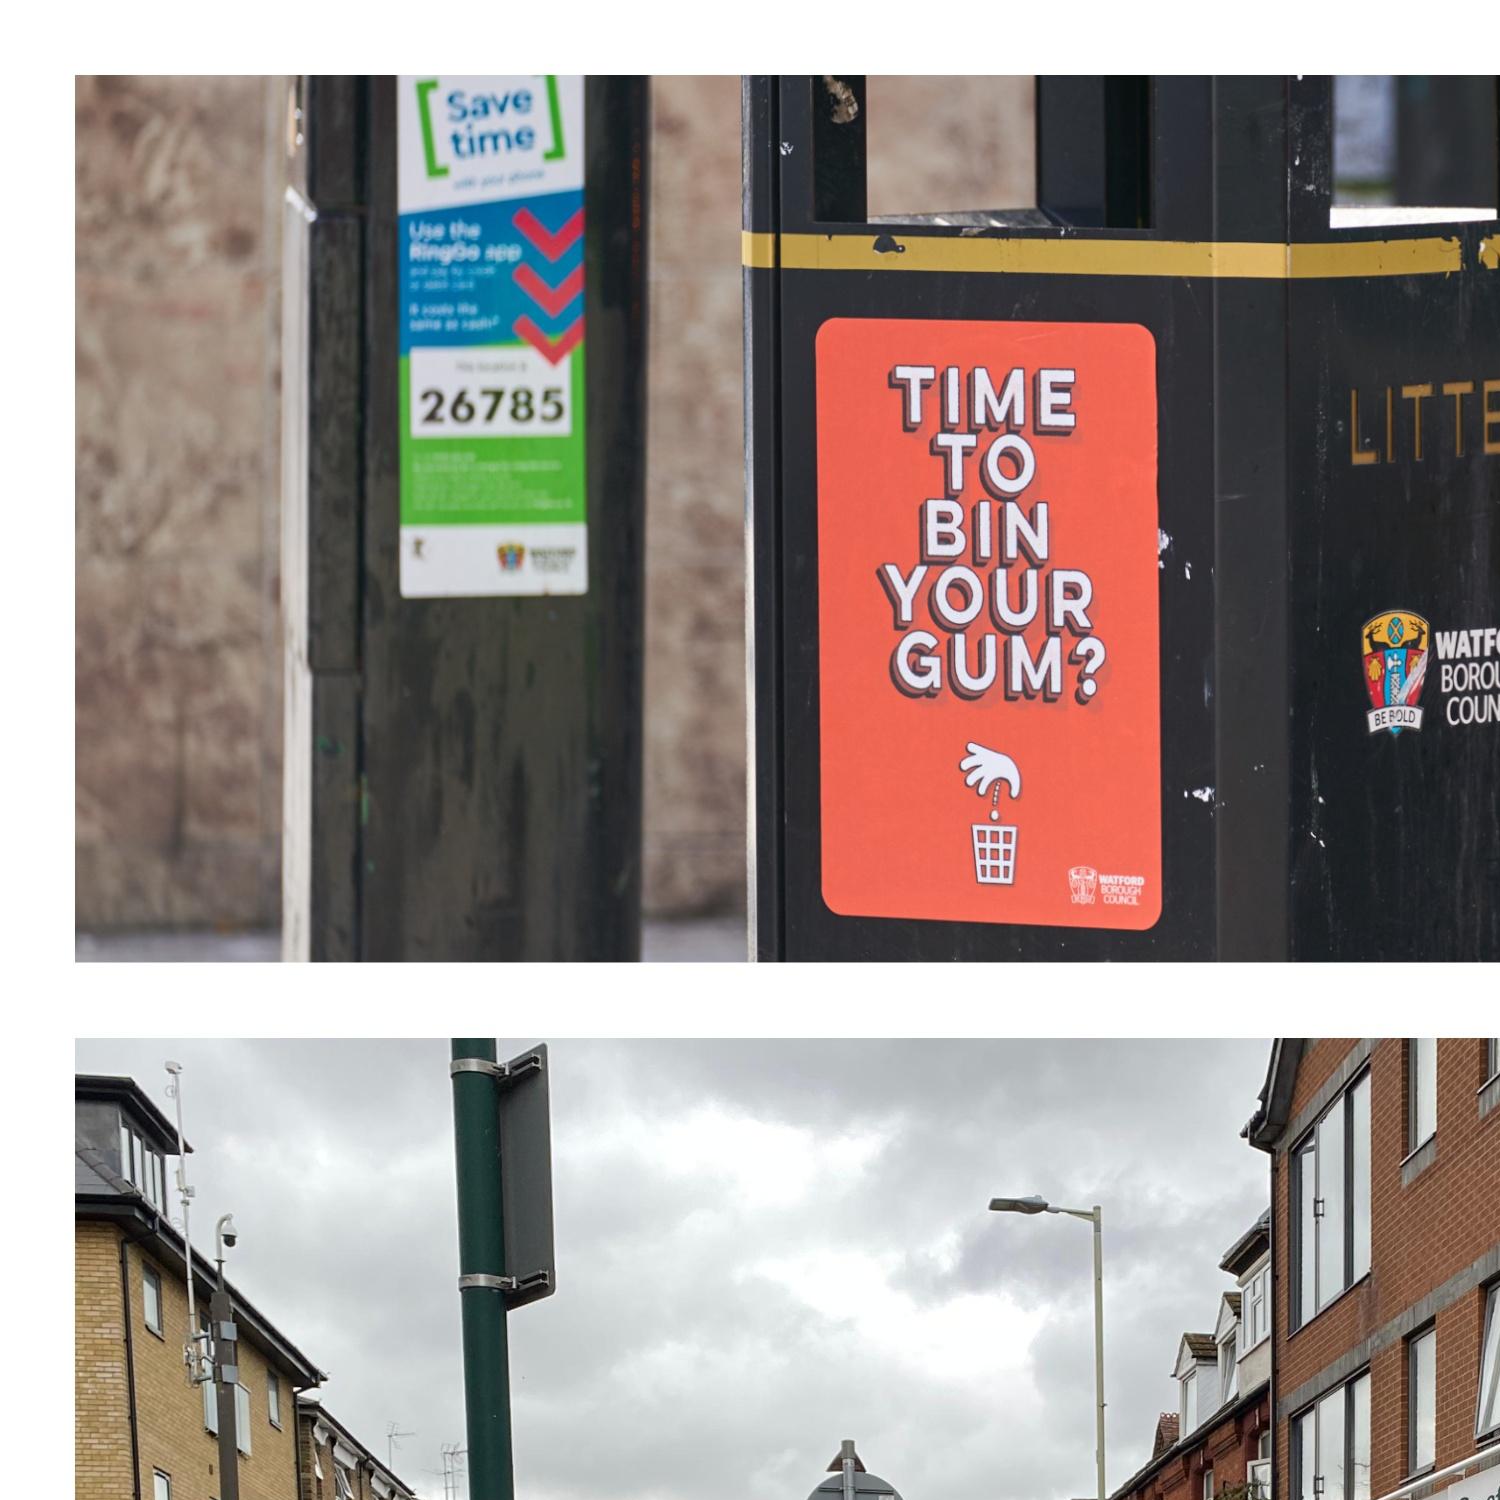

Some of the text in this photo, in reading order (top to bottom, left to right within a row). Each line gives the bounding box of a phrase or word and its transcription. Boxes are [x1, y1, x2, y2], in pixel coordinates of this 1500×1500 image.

[447, 89, 532, 121] Save
[450, 123, 536, 158] time
[409, 218, 481, 241] Use the
[485, 244, 522, 263] app
[420, 388, 564, 424] 26785
[888, 365, 1076, 435] TIME
[929, 433, 1036, 500] TO
[919, 498, 1049, 568] BIN
[876, 563, 1093, 636] YOUR
[889, 630, 1107, 706] GUM?
[1374, 710, 1416, 727] BE BOLD
[1099, 875, 1145, 886] WATFORD
[1101, 885, 1142, 895] BOROUGH
[1103, 895, 1140, 905] COUNCIL
